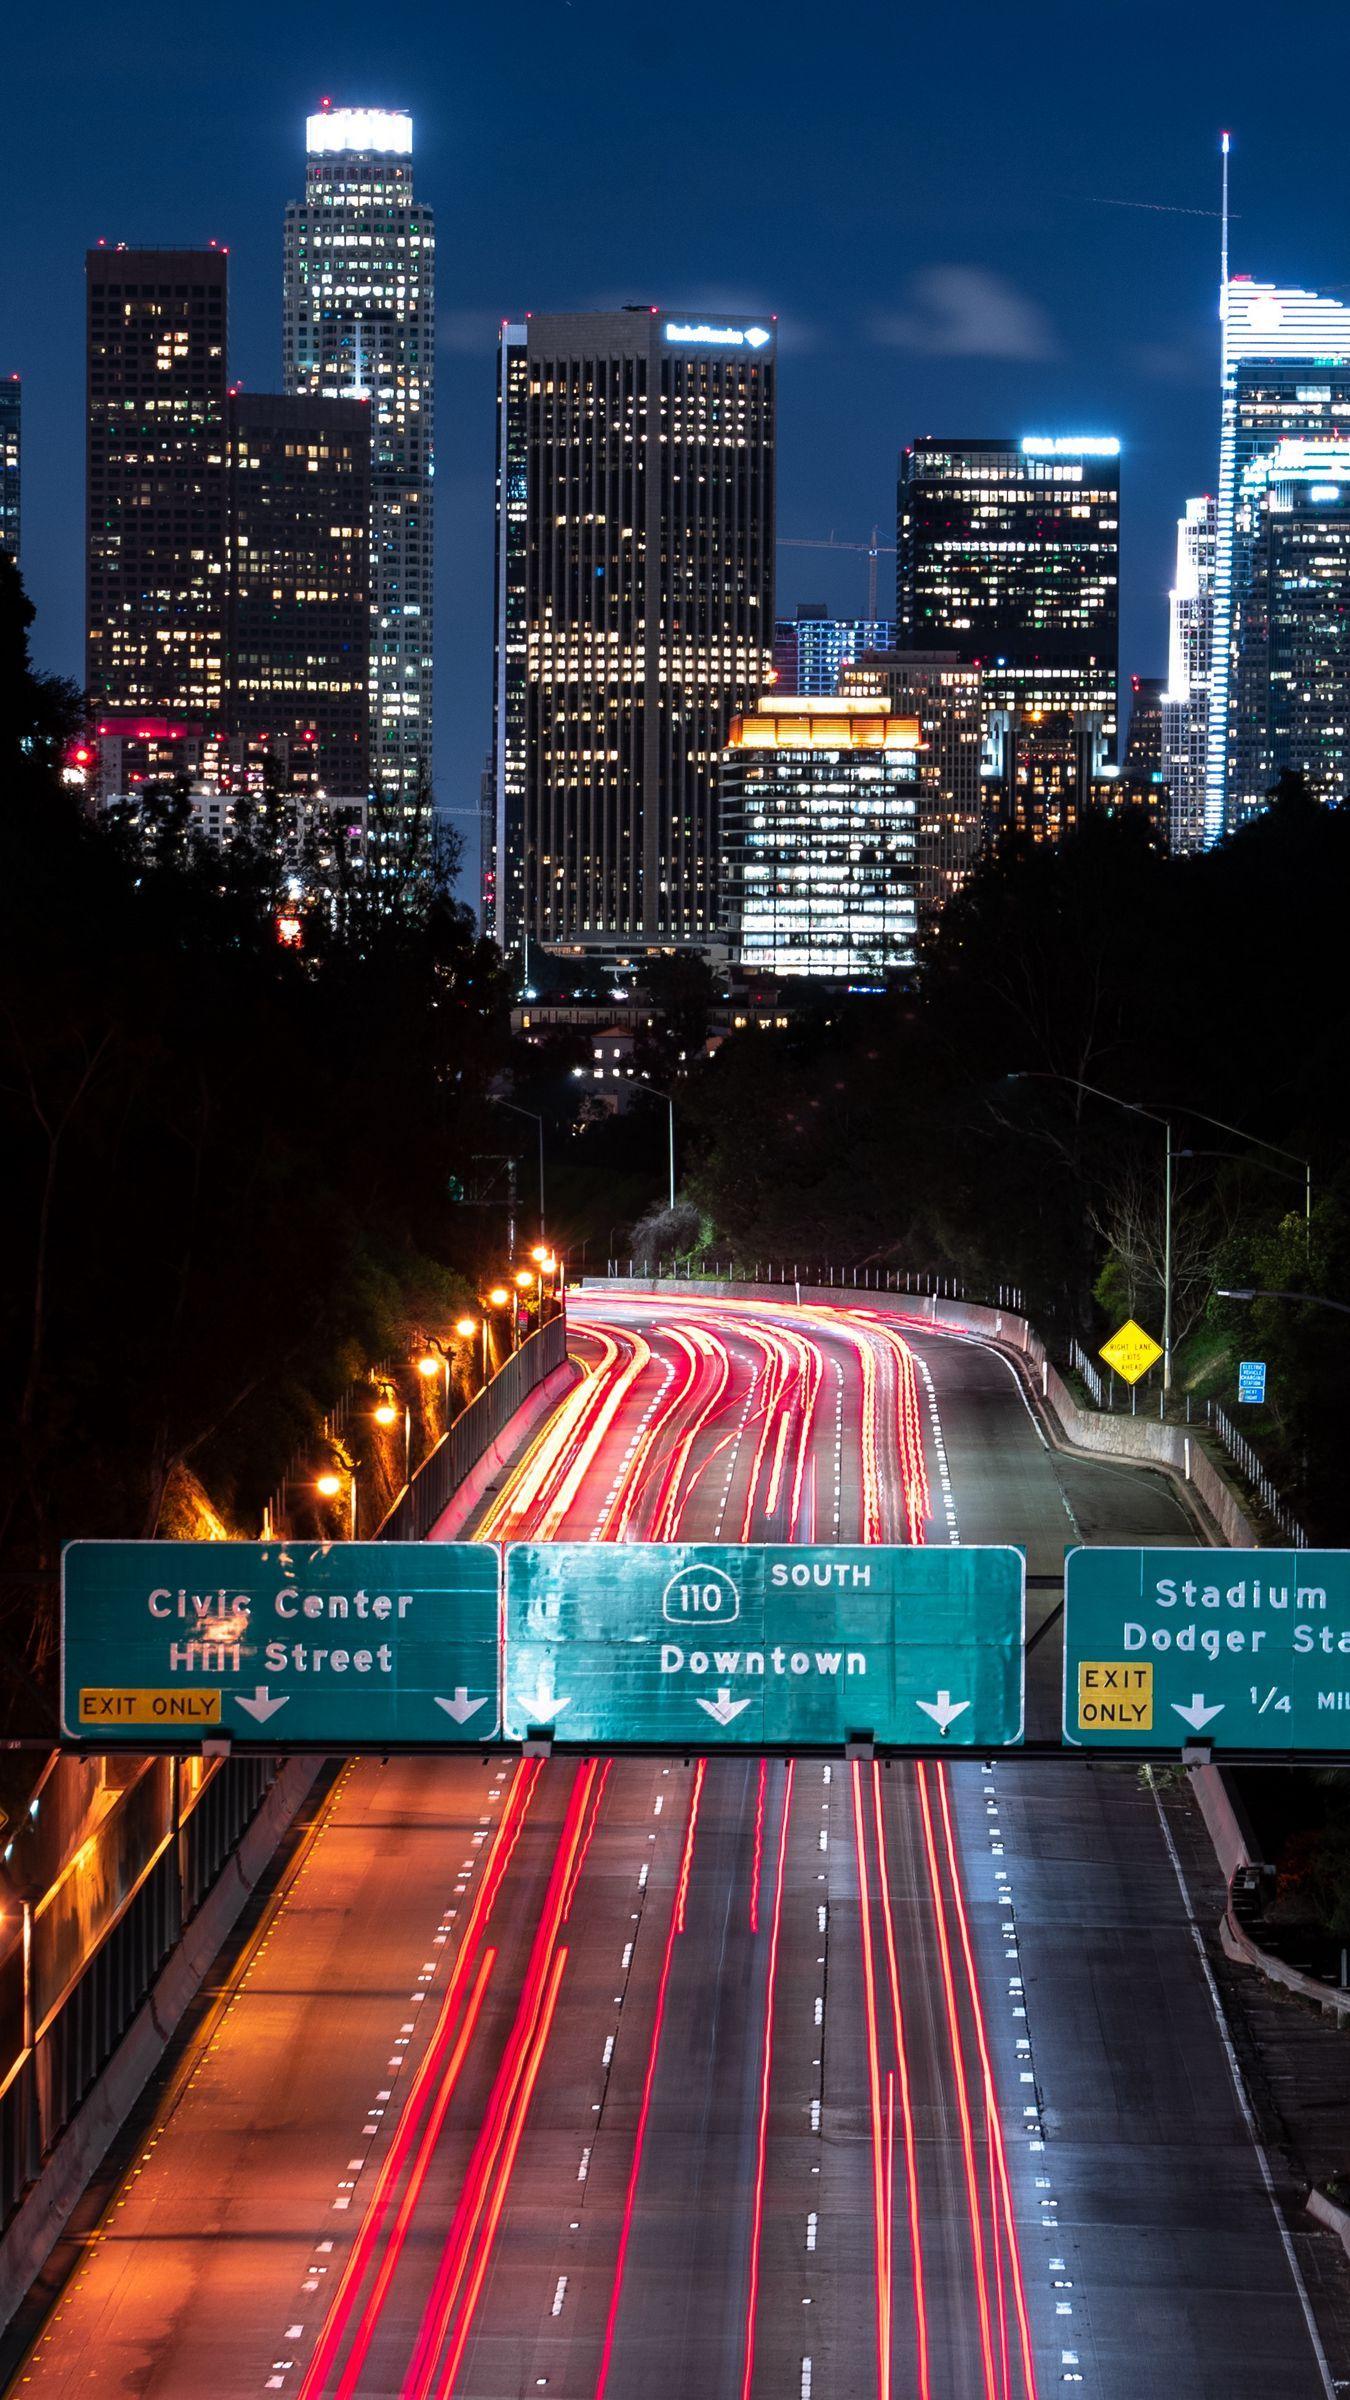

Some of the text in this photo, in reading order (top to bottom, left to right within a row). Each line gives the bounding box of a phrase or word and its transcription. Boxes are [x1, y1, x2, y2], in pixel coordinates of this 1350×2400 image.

[1109, 1343, 1152, 1351] RIGHT LANE
[1122, 1353, 1141, 1361] EXITS
[1121, 1363, 1143, 1371] AHEAD
[771, 1564, 872, 1587] SOUTH
[148, 1588, 413, 1619] Civic Center
[680, 1584, 722, 1611] 110
[1156, 1579, 1327, 1609] Stadium
[1124, 1623, 1266, 1661] Dodger
[169, 1642, 392, 1672] Hill Street
[661, 1645, 867, 1676] Downtown
[1085, 1670, 1147, 1688] EXIT
[83, 1697, 215, 1715] EXIT ONLY
[1082, 1704, 1147, 1722] ONLY
